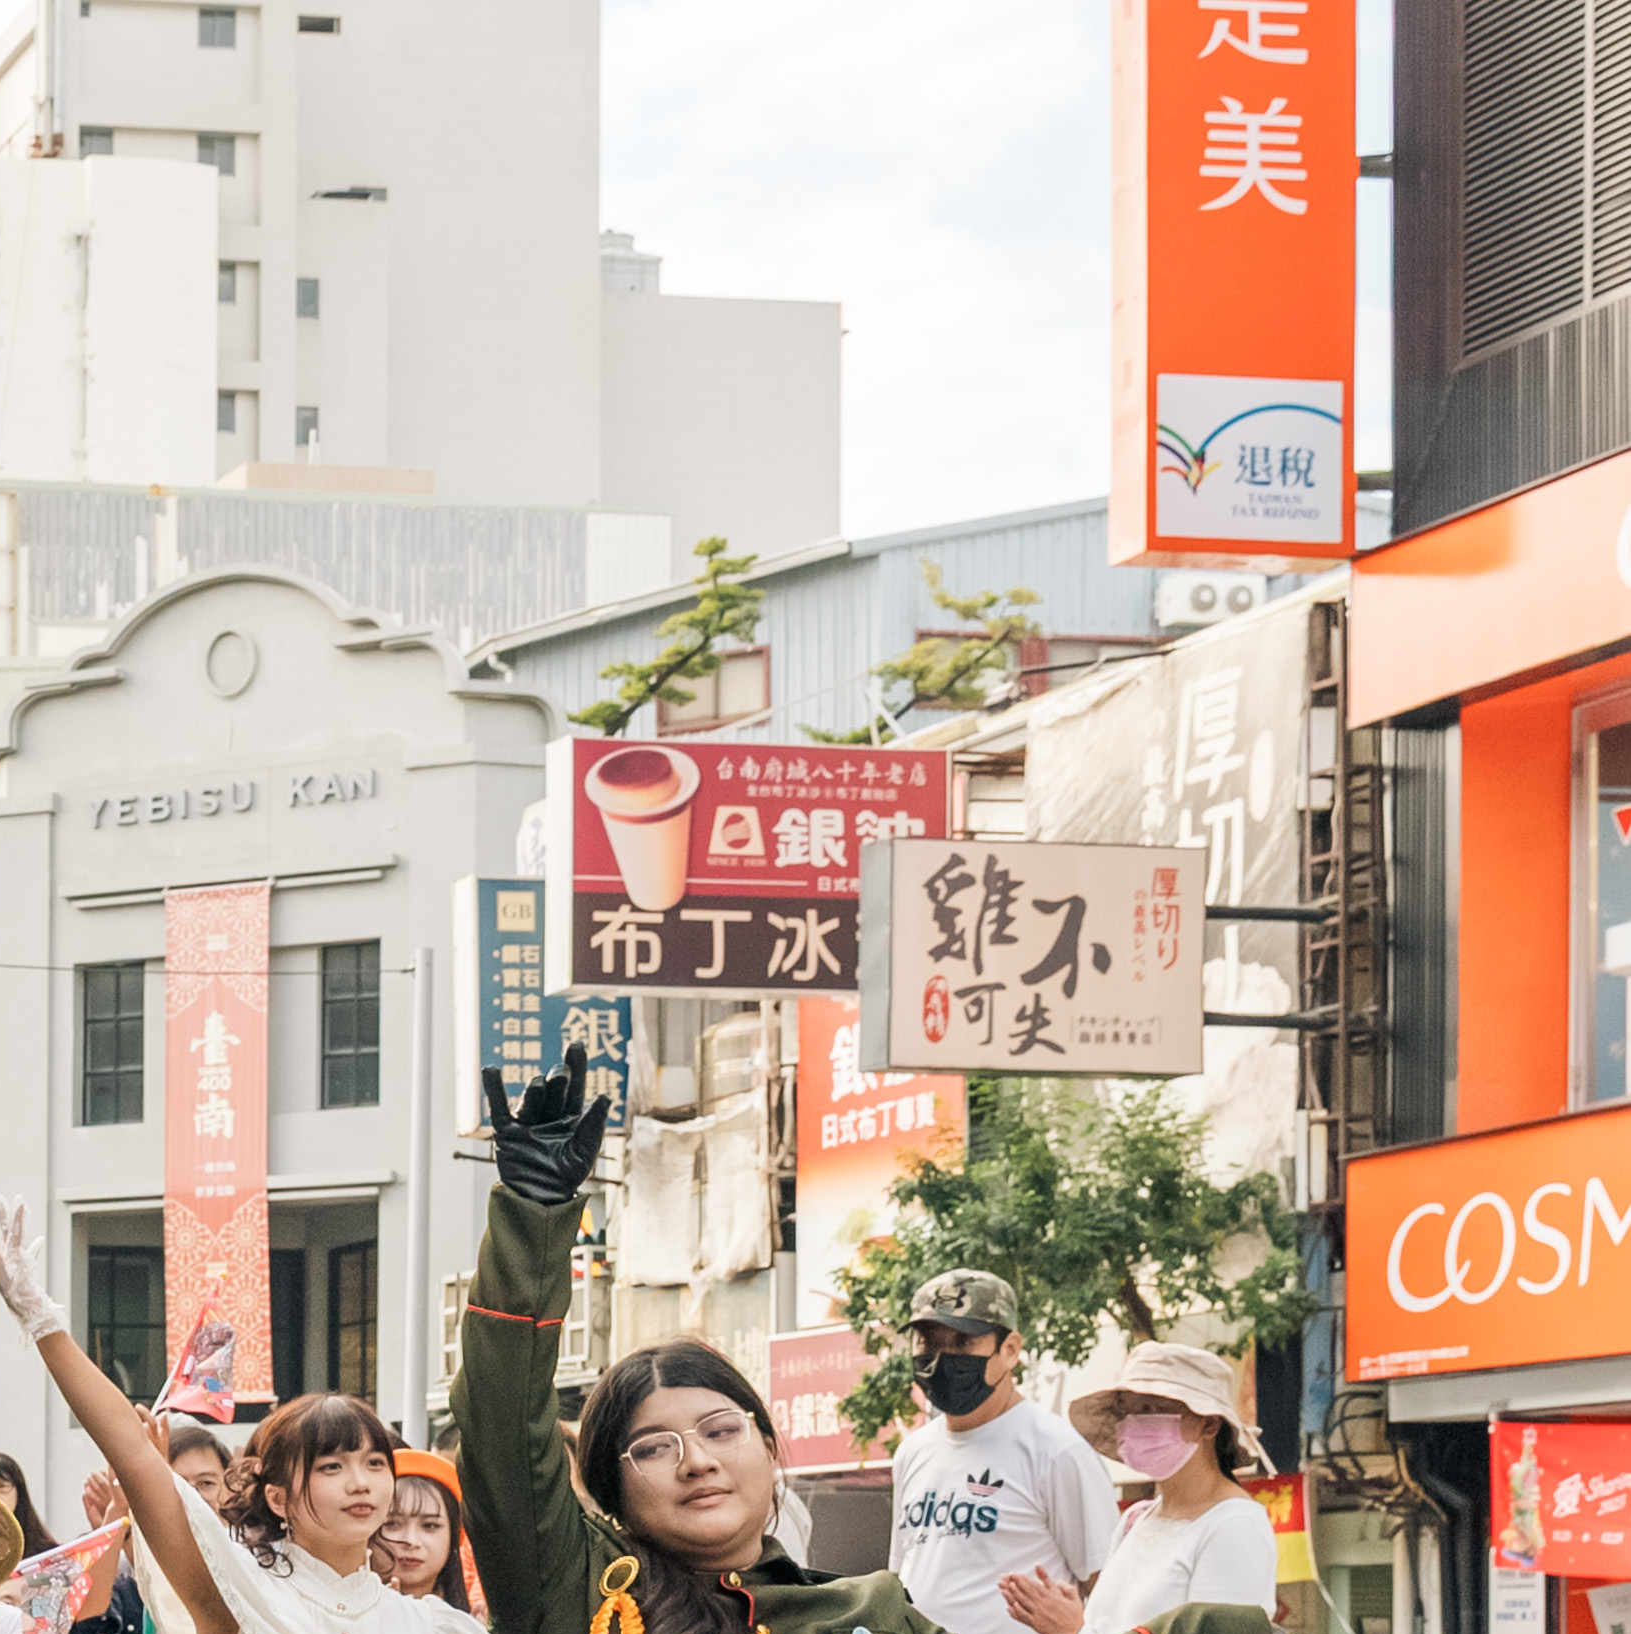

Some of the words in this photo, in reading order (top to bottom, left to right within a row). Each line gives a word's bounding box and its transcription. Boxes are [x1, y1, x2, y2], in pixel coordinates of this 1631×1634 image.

[1236, 444, 1315, 488] 退稅
[1232, 505, 1258, 517] TAX
[91, 780, 257, 830] YEBISU
[289, 768, 377, 808] KAN
[502, 903, 532, 920] GB
[589, 904, 861, 983] 布丁冰
[502, 1016, 542, 1036] 白金
[196, 1075, 233, 1092] 400
[899, 1491, 998, 1533] adidas
